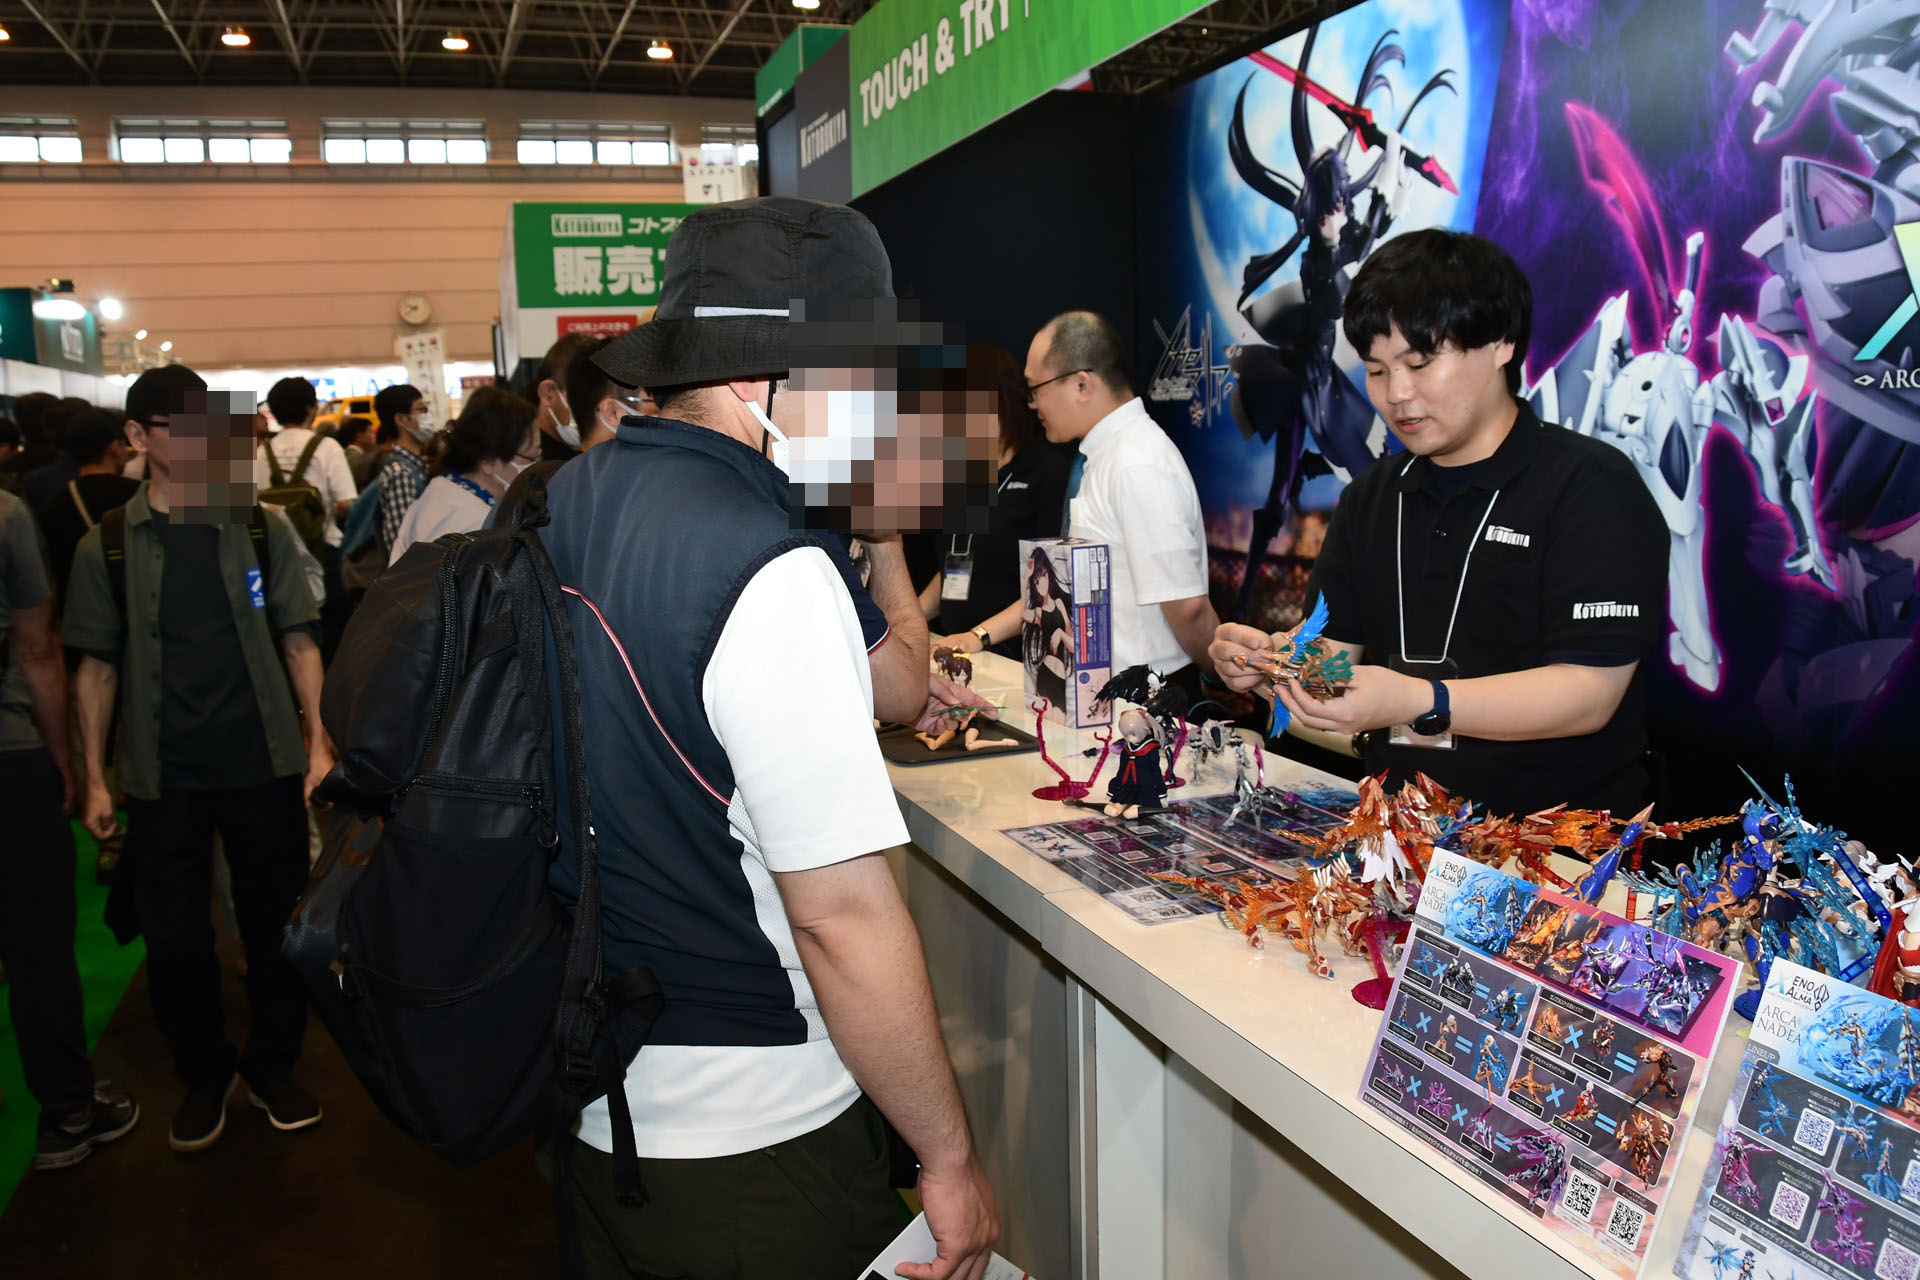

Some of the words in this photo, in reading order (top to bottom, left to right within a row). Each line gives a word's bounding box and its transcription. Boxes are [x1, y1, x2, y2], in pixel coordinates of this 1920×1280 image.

[860, 33, 928, 127] TOUCH
[935, 17, 955, 75] &
[553, 245, 666, 295] 販売
[1572, 601, 1640, 619] KOTOBUKIYA
[1785, 986, 1812, 1005] ALMA
[1762, 1004, 1797, 1028] ARCA
[1757, 1017, 1801, 1045] NADEA
[1746, 1043, 1776, 1061] LINEUP
